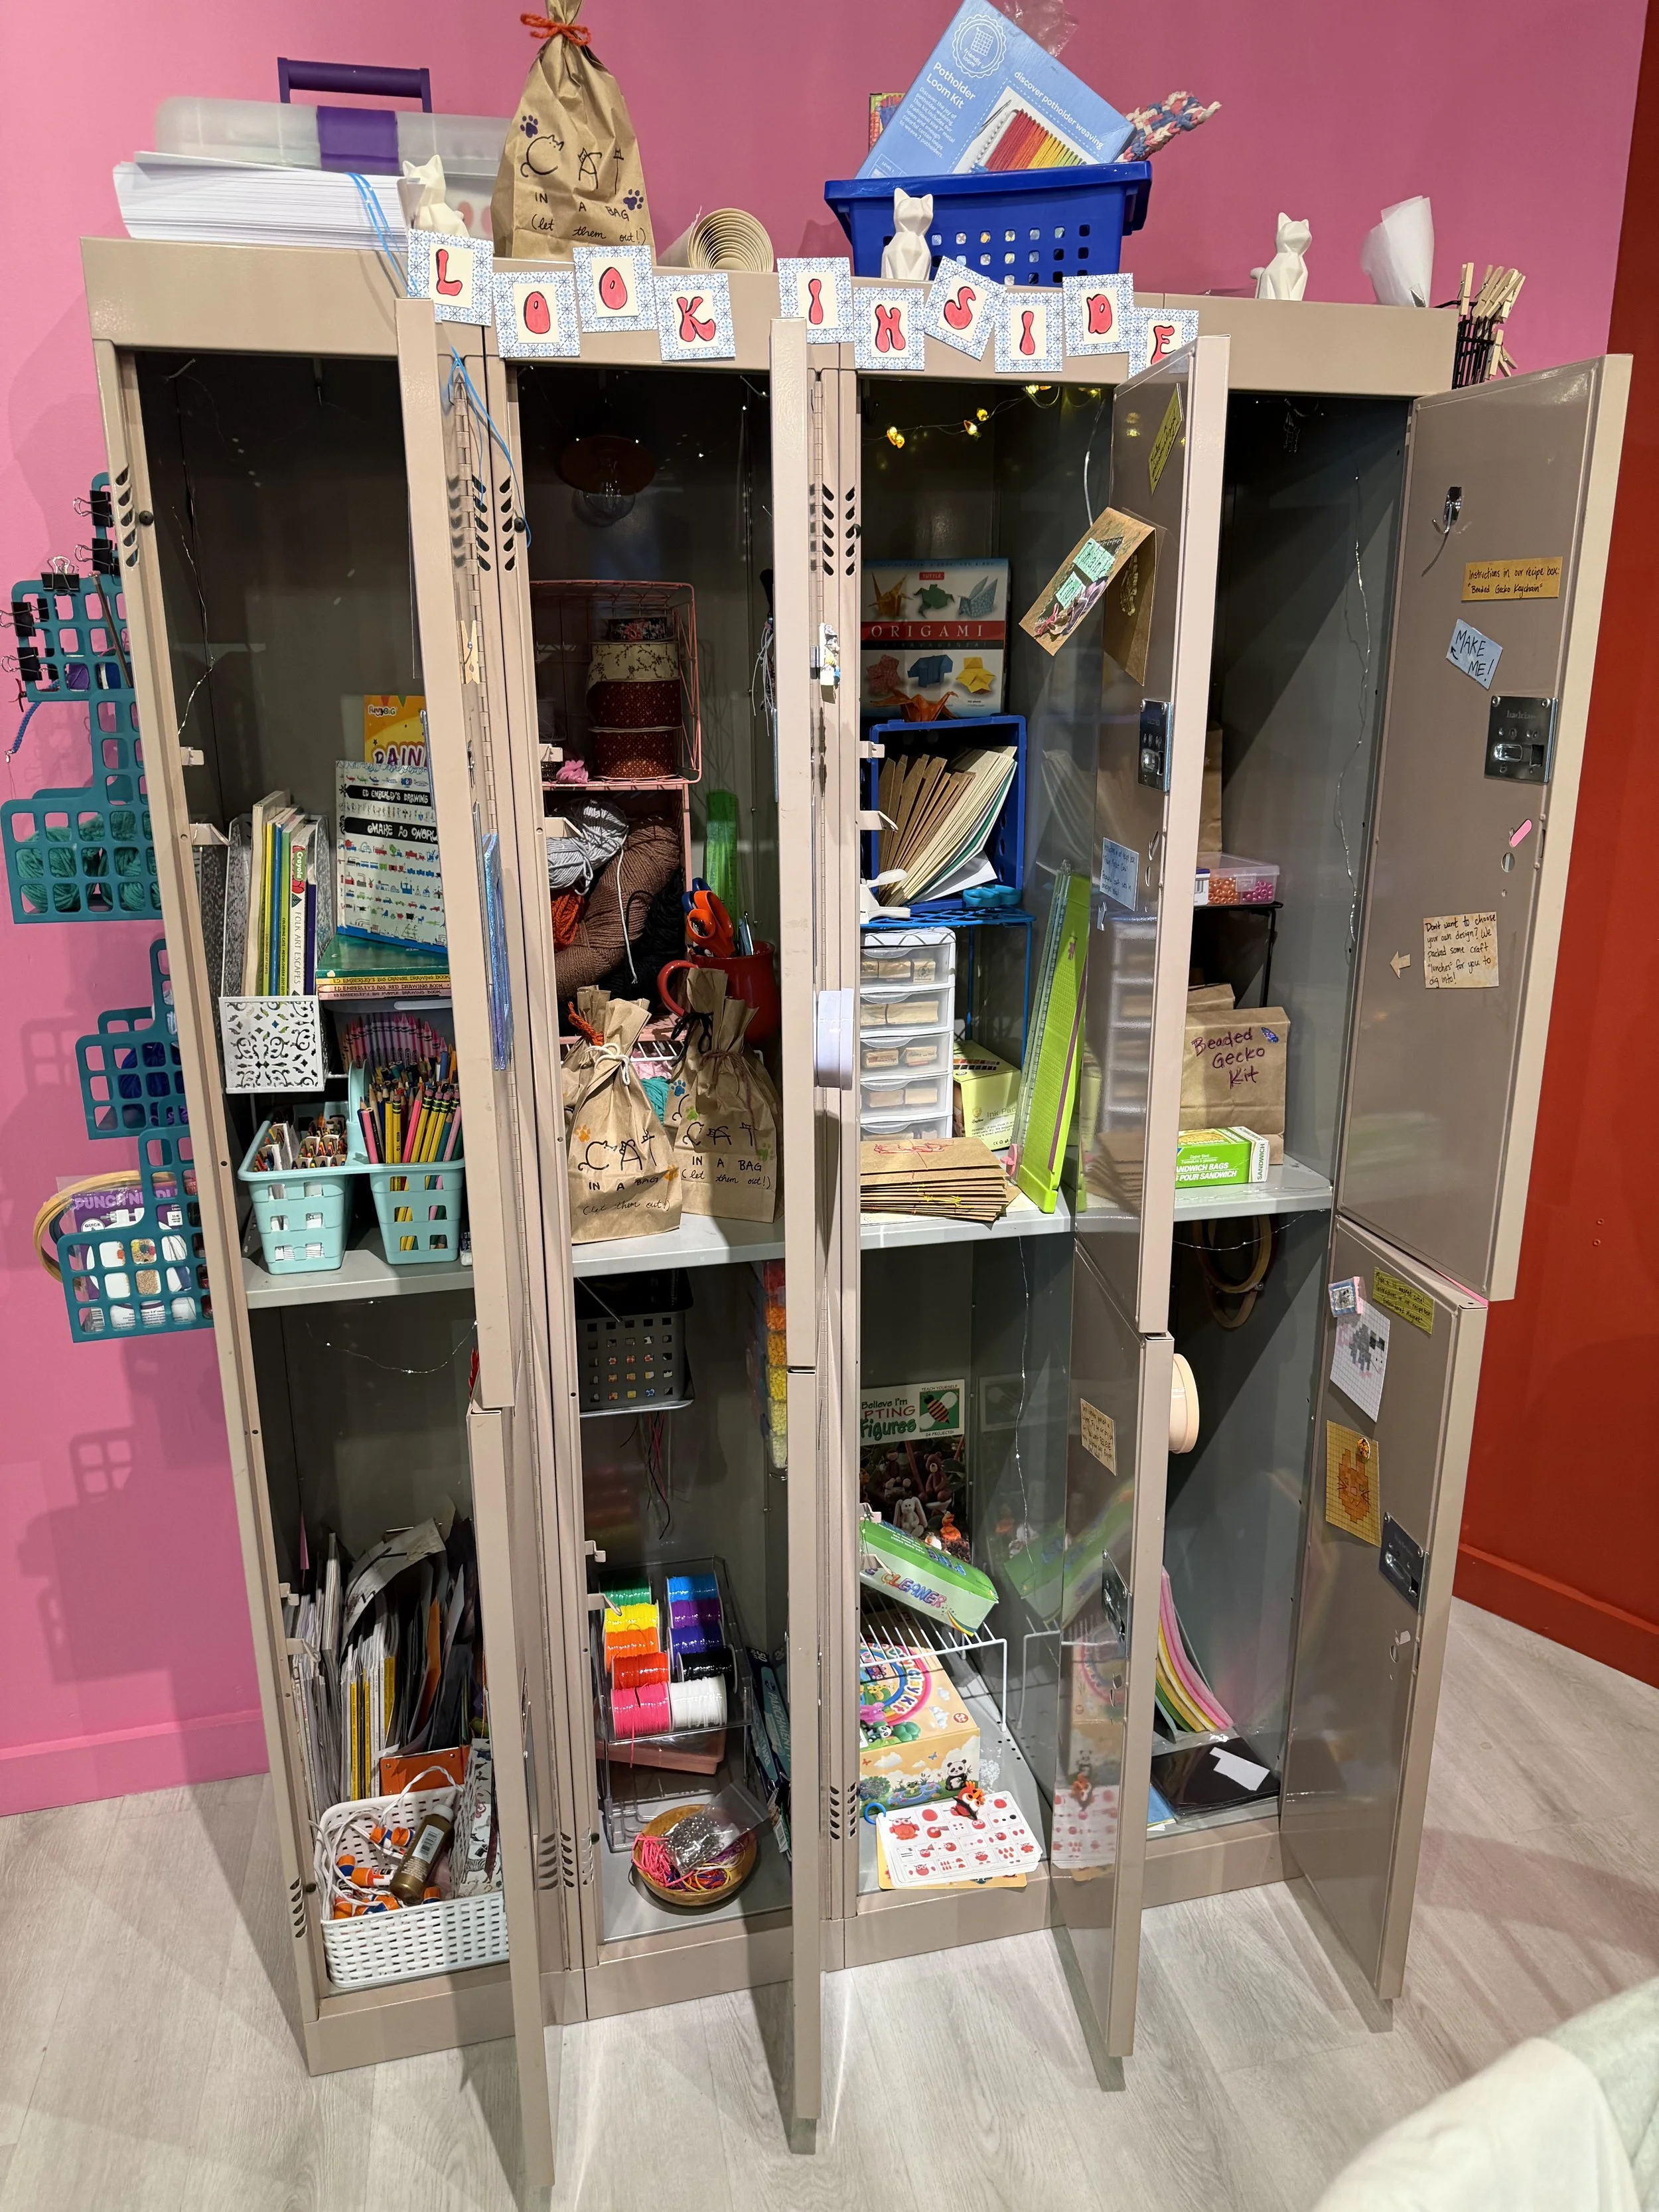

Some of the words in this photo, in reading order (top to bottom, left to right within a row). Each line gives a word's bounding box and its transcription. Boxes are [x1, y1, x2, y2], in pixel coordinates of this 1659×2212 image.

[925, 73, 951, 98] Loom
[950, 93, 964, 109] Kit
[932, 61, 977, 101] Potholder
[915, 92, 936, 111] potholder
[919, 86, 938, 104] Discover
[936, 101, 945, 110] the
[943, 107, 952, 116] joy
[1014, 71, 1043, 98] discover
[1042, 96, 1076, 125] potholder
[1076, 123, 1104, 150] weaving
[908, 104, 930, 123] traditional
[942, 131, 955, 143] metal
[912, 98, 922, 108] This
[926, 110, 944, 127] includes
[902, 114, 919, 130] colorful
[917, 127, 932, 141] cotton
[903, 125, 917, 137] weave
[905, 109, 917, 120] loom
[916, 118, 925, 127] and
[924, 125, 940, 140] enough
[520, 135, 624, 194] CAT
[535, 192, 548, 203] IN
[579, 202, 586, 212] A
[605, 205, 629, 221] BAG
[532, 214, 554, 231] (let
[572, 228, 607, 239] them
[620, 228, 646, 245] out!)
[436, 249, 717, 342] LOOK
[807, 278, 1177, 365] INSIDE
[1469, 567, 1500, 580] Instructions
[1503, 569, 1510, 578] in
[1526, 566, 1544, 579] recipe
[1546, 565, 1559, 575] box:
[1495, 585, 1510, 594] Gecko
[871, 625, 983, 637] ORIGAMI
[1455, 630, 1486, 657] MAKE
[1468, 659, 1494, 682] ME!
[371, 790, 401, 802] EMBERLEY'S
[403, 793, 429, 804] DRAWING
[367, 823, 393, 836] MAKE
[1444, 919, 1458, 928] want
[1463, 916, 1469, 926] to
[1475, 913, 1496, 925] choose
[1427, 935, 1438, 948] your
[1455, 928, 1479, 942] design?
[1481, 927, 1492, 938] We
[1427, 946, 1446, 962] packed
[1470, 942, 1489, 953] craft
[1455, 959, 1464, 970] for
[1468, 962, 1480, 974] you
[1483, 956, 1491, 966] to
[1429, 977, 1439, 988] dig
[1441, 972, 1457, 984] into!
[1191, 1027, 1253, 1057] Beaded
[1212, 1047, 1265, 1069] Gecko
[1229, 1065, 1259, 1089] Kit
[682, 1121, 758, 1146] CAT
[578, 1128, 658, 1171] CAT
[692, 1155, 703, 1166] IN
[717, 1157, 725, 1168] A
[738, 1159, 762, 1171] BAG
[589, 1182, 601, 1191] IN
[616, 1183, 625, 1191] A
[634, 1176, 659, 1186] BAG
[682, 1169, 705, 1181] (let
[715, 1175, 739, 1184] them
[747, 1175, 771, 1189] out!)
[1200, 1170, 1237, 1179] SANDWICH
[74, 1194, 126, 1210] PUNCH
[614, 1201, 640, 1211] them
[646, 1200, 671, 1211] out!)
[861, 1400, 892, 1410] Believe
[865, 1406, 915, 1419] PTING
[860, 1418, 916, 1441] Figures
[882, 1573, 946, 1607] CLEANER
[893, 1696, 915, 1712] Kit
